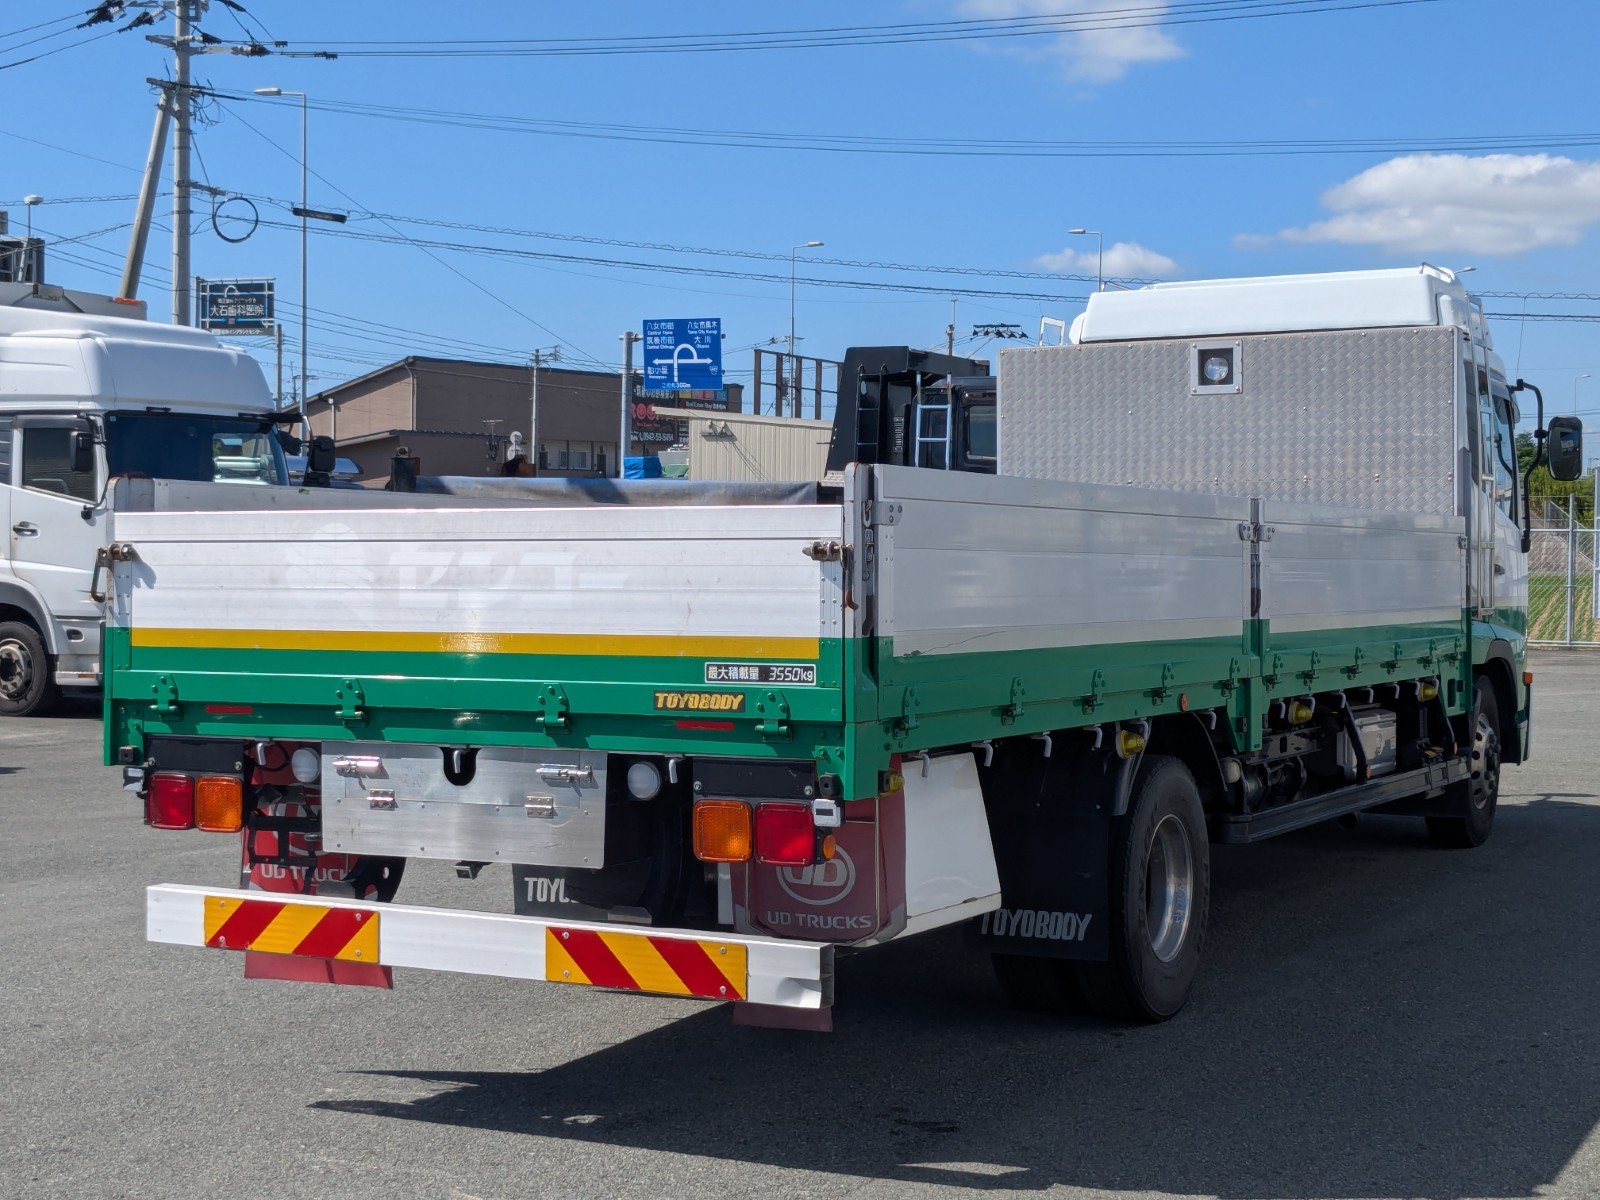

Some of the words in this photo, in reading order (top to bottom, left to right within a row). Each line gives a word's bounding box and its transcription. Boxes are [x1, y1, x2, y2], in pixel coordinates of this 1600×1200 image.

[210, 305, 264, 316] 大石歯科医院
[646, 322, 674, 330] 八女市街
[687, 321, 718, 329] 八女市黒木
[646, 336, 674, 344] 筑後市街
[647, 366, 668, 375] 船小屋
[707, 665, 760, 681] 最大積載量
[768, 666, 815, 683] 3550kg
[655, 692, 744, 711] TOYOBODY
[767, 910, 792, 926] UD
[795, 913, 872, 930] TRUCKS
